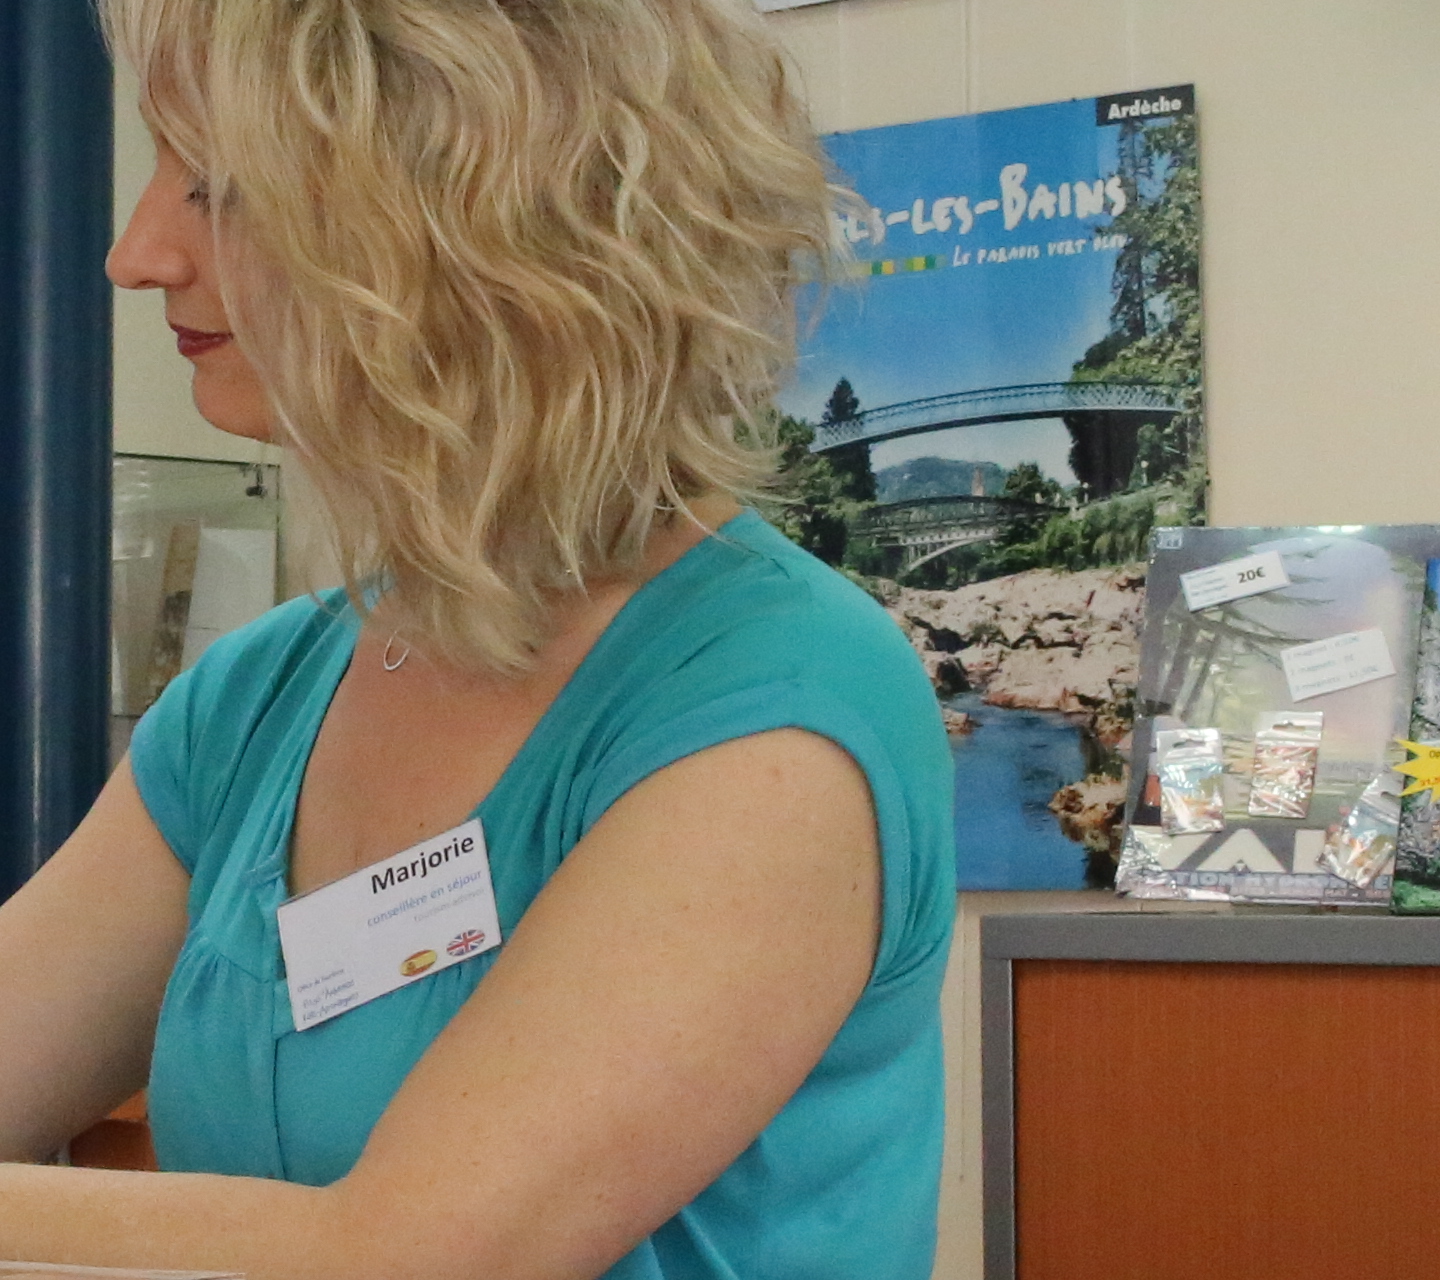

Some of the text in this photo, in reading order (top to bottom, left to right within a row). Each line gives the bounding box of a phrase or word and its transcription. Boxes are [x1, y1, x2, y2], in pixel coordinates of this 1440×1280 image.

[1107, 95, 1183, 120] Ardèche
[830, 163, 1126, 245] LS-LES-BAINS
[1237, 566, 1266, 584] 20€
[370, 835, 475, 895] Marjorie
[365, 870, 483, 928] conseillère en séjour
